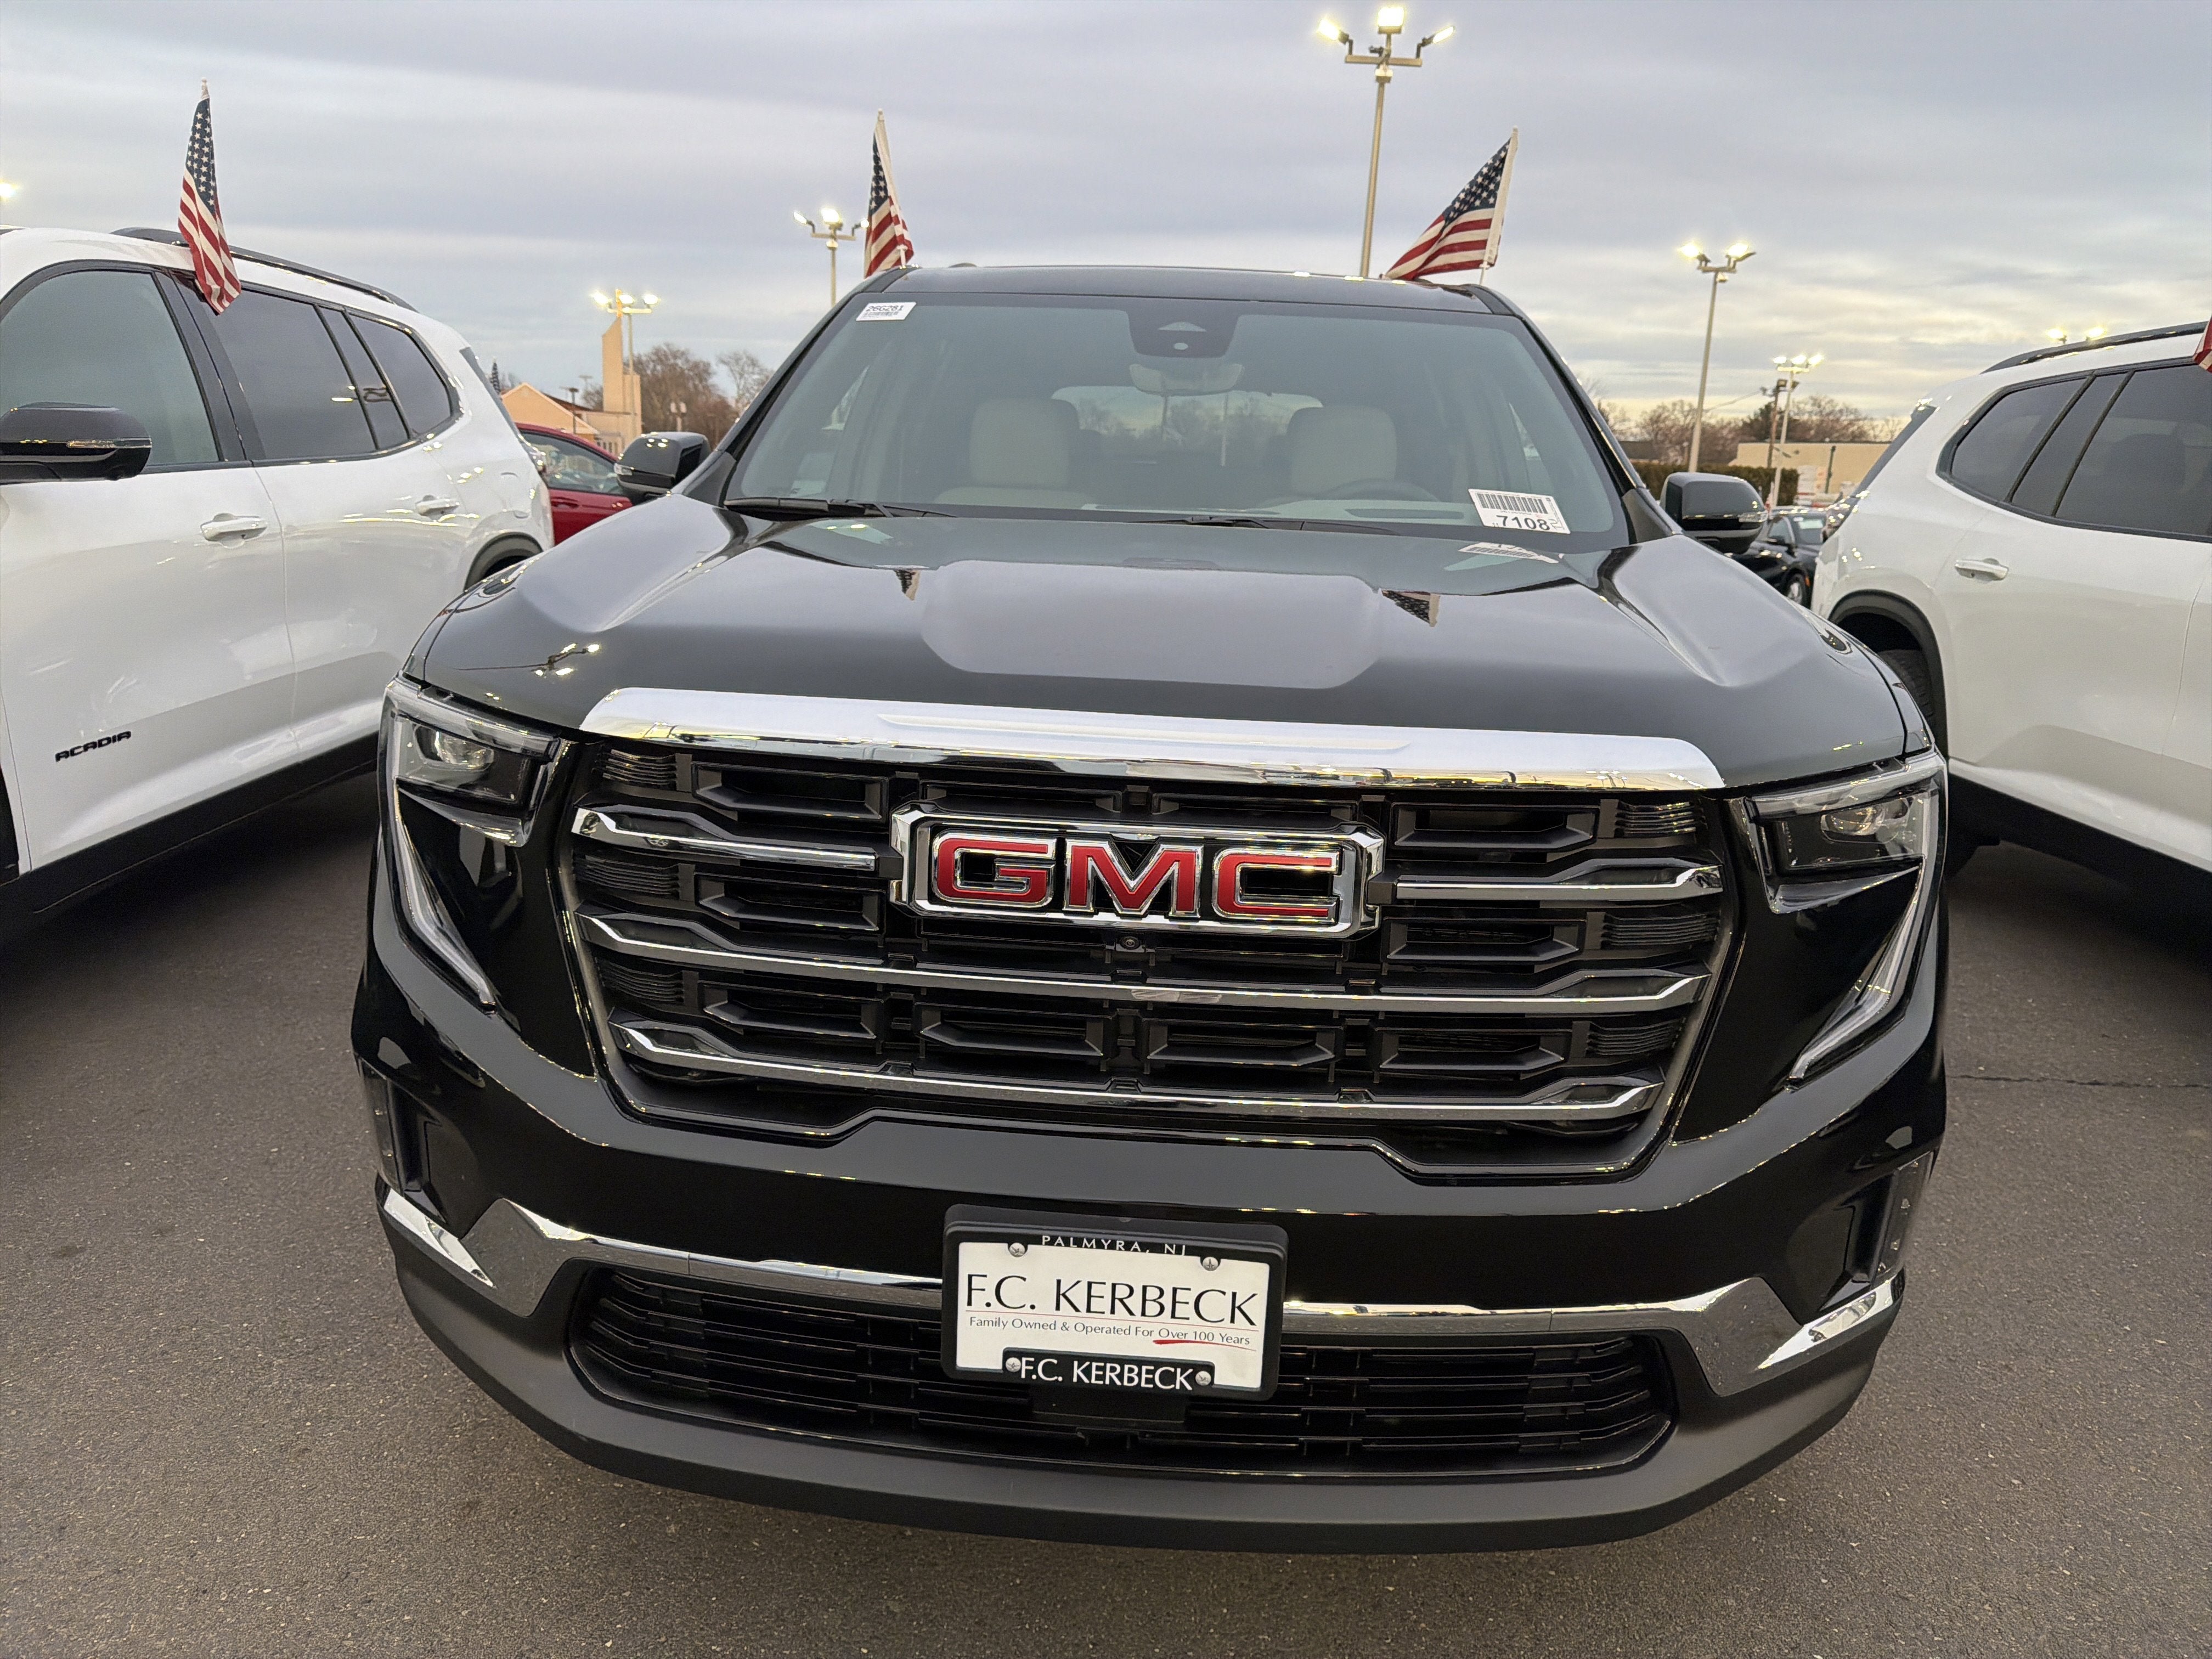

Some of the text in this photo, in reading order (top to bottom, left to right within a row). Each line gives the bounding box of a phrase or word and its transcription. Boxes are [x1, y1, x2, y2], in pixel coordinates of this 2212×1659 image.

[1496, 515, 1550, 531] 7108
[55, 731, 132, 763] ACADIA
[932, 830, 1343, 924] GMC
[1042, 1235, 1186, 1255] PALMYRA, NJ
[967, 1273, 1259, 1327] F.C. KERBECK
[969, 1316, 1250, 1345] Family Owned & Operated For Over 100 Years
[1020, 1357, 1194, 1391] F.C. KERBECK
